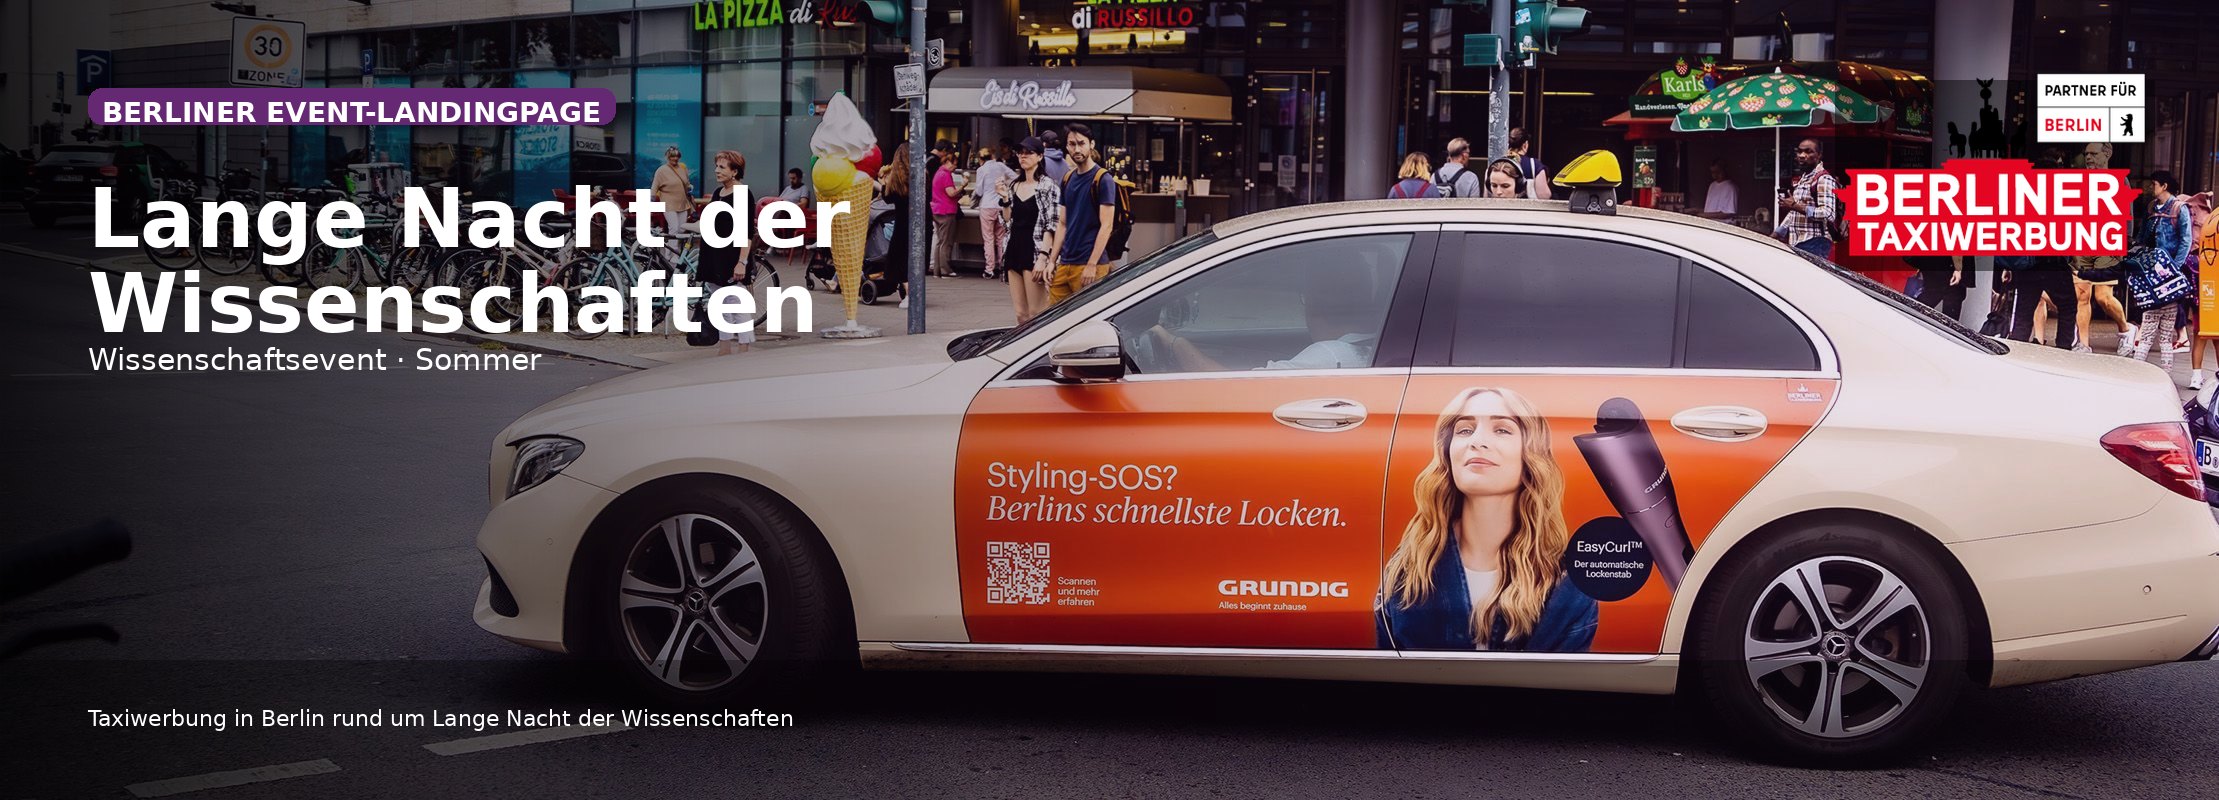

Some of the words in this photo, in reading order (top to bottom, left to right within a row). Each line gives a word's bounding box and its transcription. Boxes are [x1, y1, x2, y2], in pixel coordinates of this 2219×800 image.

[694, 2, 718, 30] LA
[723, 0, 784, 29] PIZZA
[789, 0, 814, 24] di
[1072, 6, 1091, 29] di
[1097, 7, 1194, 28] RUSSILLO
[255, 36, 282, 57] 30
[86, 62, 103, 83] P
[1664, 75, 1706, 92] Karls
[980, 79, 1004, 109] Eis
[1003, 80, 1019, 106] di
[1018, 81, 1077, 109] Russillo
[987, 461, 1178, 495] Styling-SOS?
[986, 495, 1088, 523] Berlins
[1092, 495, 1232, 525] schnellste
[1238, 499, 1347, 527] Locken.
[1574, 560, 1589, 568] Der
[1589, 560, 1644, 569] automatische
[1586, 570, 1632, 578] Lockenstab
[1057, 576, 1097, 586] Scannen
[1218, 579, 1349, 598] GRUNDIG
[1057, 586, 1076, 596] und
[1076, 587, 1100, 597] mehr
[1057, 597, 1095, 606] erfahren
[1219, 601, 1239, 610] Alles
[1240, 601, 1271, 611] beginnt
[1272, 603, 1307, 611] zuhause
